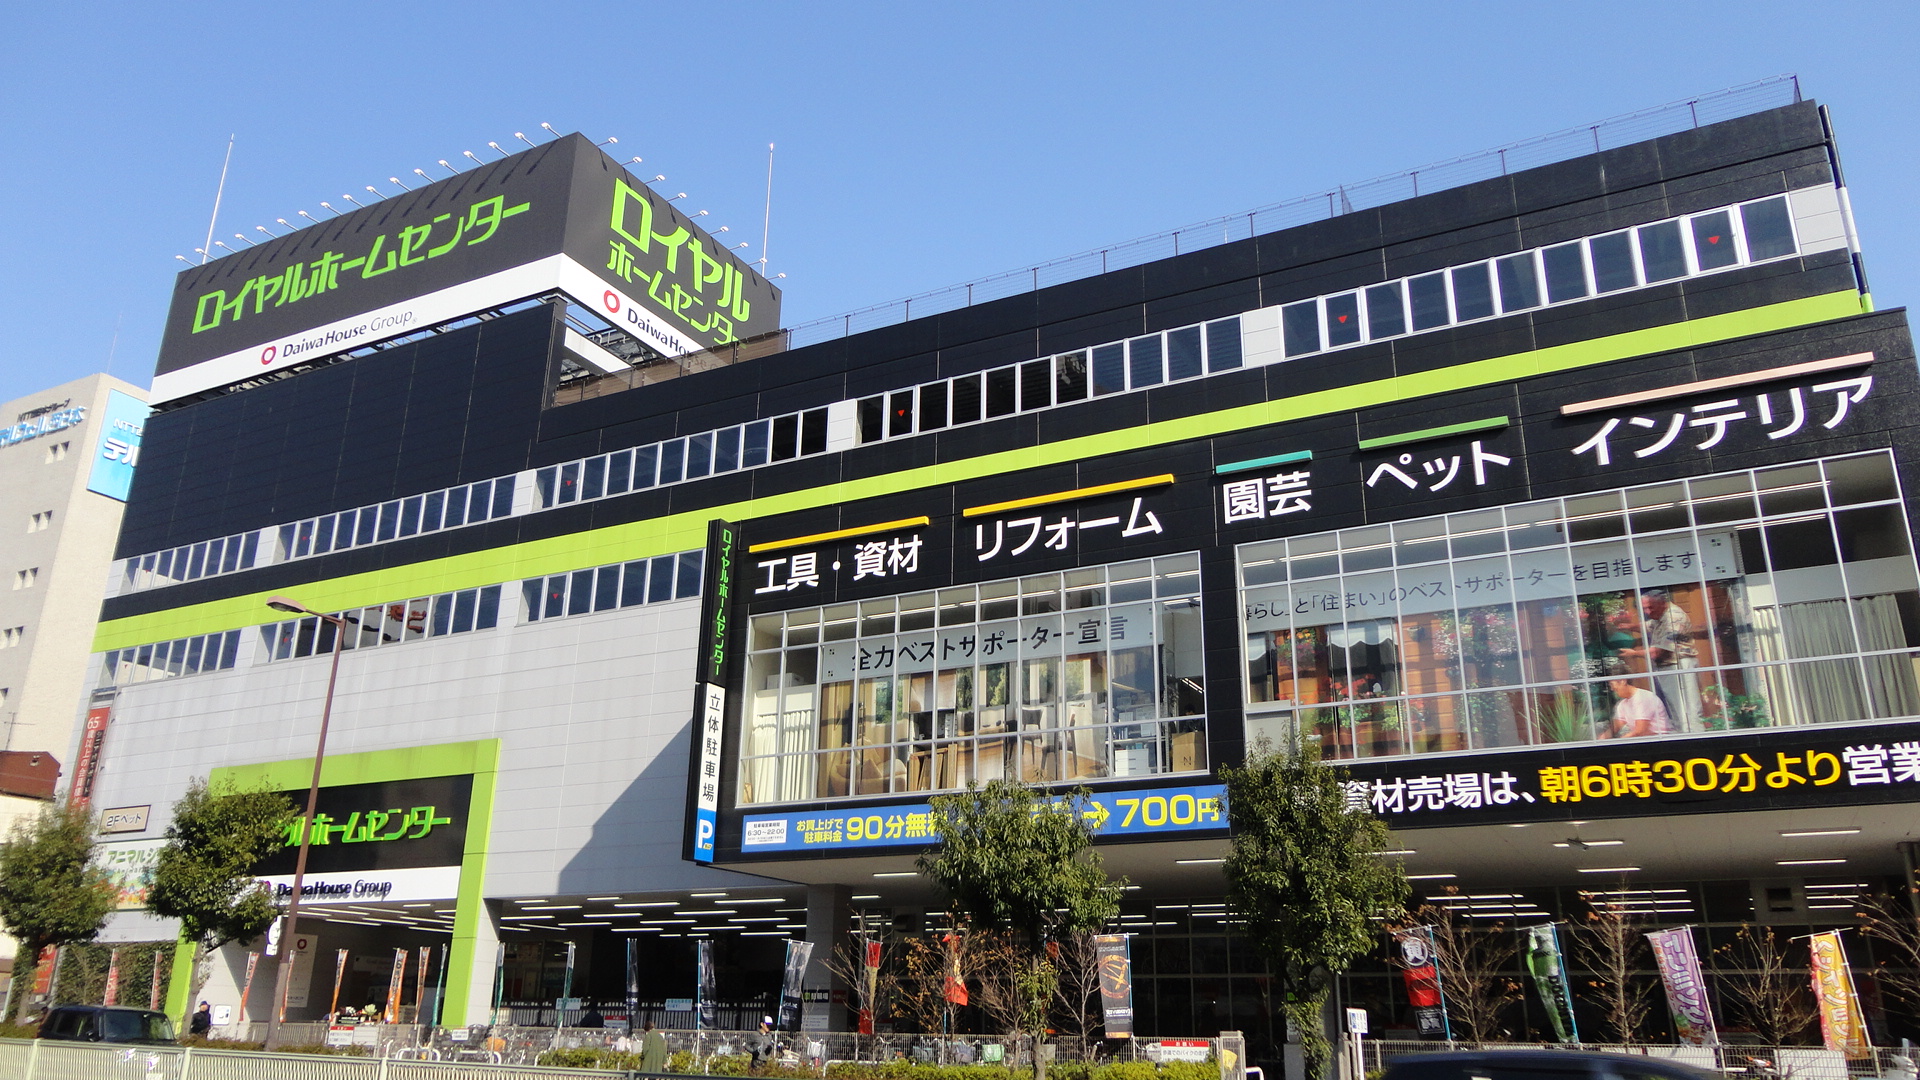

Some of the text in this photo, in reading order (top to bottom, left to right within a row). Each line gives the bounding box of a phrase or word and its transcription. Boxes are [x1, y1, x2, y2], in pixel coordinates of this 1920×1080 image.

[191, 194, 530, 334] ロイヤルホームセンター
[610, 177, 750, 322] ロイヤル
[370, 311, 413, 332] Group
[1571, 375, 1872, 466] インテリア
[1365, 441, 1511, 493] ペット
[1223, 471, 1313, 525] 園芸
[975, 496, 1163, 562] リフォーム
[754, 535, 923, 595] 工具・資材
[713, 528, 732, 676] ロイヤルホームセンター
[851, 614, 1128, 672] 全力ベストサポーター宣言
[702, 693, 721, 803] 立体駐車場
[697, 818, 713, 849] P
[796, 818, 843, 832] お買上げで
[803, 830, 842, 844] 駐車料金
[354, 879, 392, 898] Group
